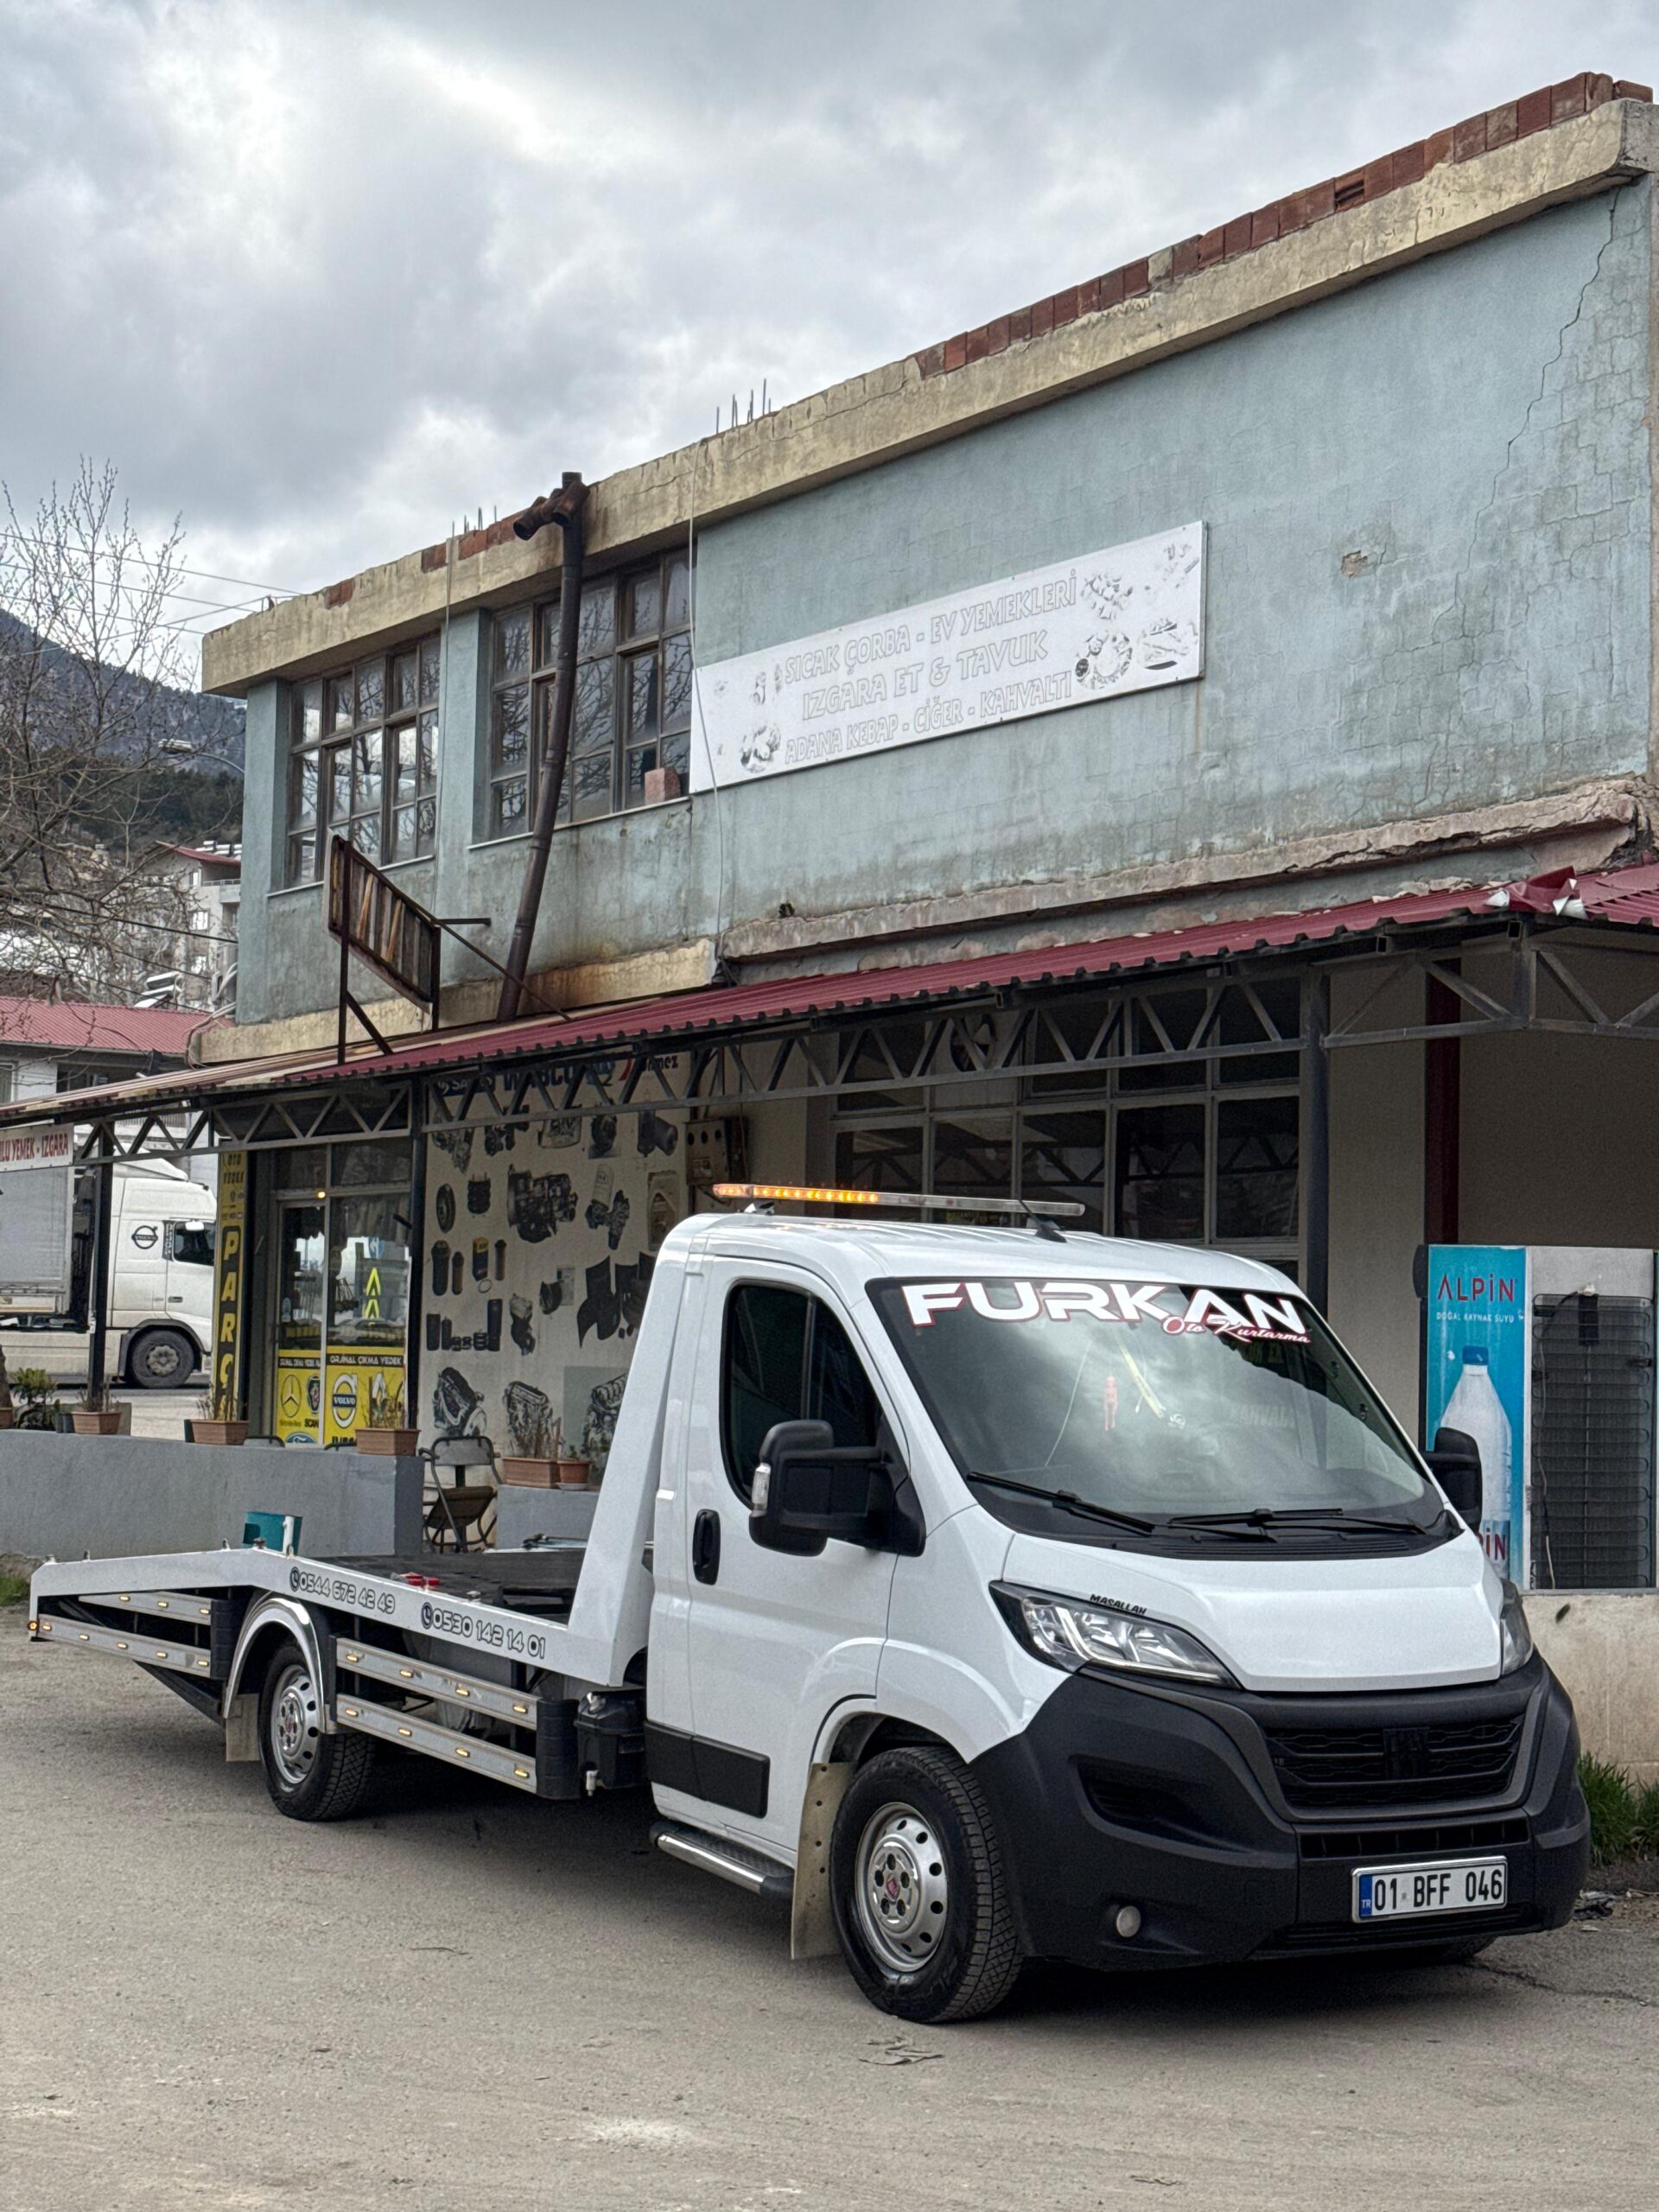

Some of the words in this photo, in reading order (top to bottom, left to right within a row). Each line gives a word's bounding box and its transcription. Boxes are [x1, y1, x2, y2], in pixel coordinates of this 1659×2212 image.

[785, 645, 840, 684] SICAK
[845, 626, 910, 675] ÇORBA
[931, 612, 957, 644] EV
[961, 569, 1077, 636] YEMEKLERİ
[803, 674, 887, 721] IZGARA
[894, 663, 924, 697] ET
[929, 657, 951, 687] &
[957, 629, 1049, 680] TAVUK
[785, 728, 842, 764] ADANA
[847, 715, 899, 750] KEBAP
[914, 696, 963, 733] CİĞER
[981, 671, 1072, 718] KAHVALTI
[12, 1137, 35, 1161] YEMEK
[41, 1133, 68, 1158] IZGARA
[227, 1154, 242, 1166] OTO
[899, 1281, 1307, 1334] FURKAN
[1436, 1312, 1462, 1321] DOĞAL
[1464, 1313, 1492, 1322] KAYNAK
[1494, 1313, 1515, 1323] SUYU
[1161, 1315, 1205, 1335] Oto
[1206, 1313, 1312, 1344] Kurtarma
[334, 1395, 356, 1405] VOLVO
[299, 1572, 331, 1598] 0544
[332, 1580, 357, 1605] 672
[358, 1587, 376, 1610] 42
[377, 1592, 396, 1615] 49
[432, 1608, 474, 1638] 0530
[476, 1619, 505, 1648] 142
[506, 1628, 524, 1654] 14
[527, 1634, 546, 1660] 01
[1362, 1899, 1370, 1909] TR
[1374, 1878, 1398, 1910] 01
[1413, 1872, 1452, 1908] BFF
[1465, 1869, 1503, 1903] 046
